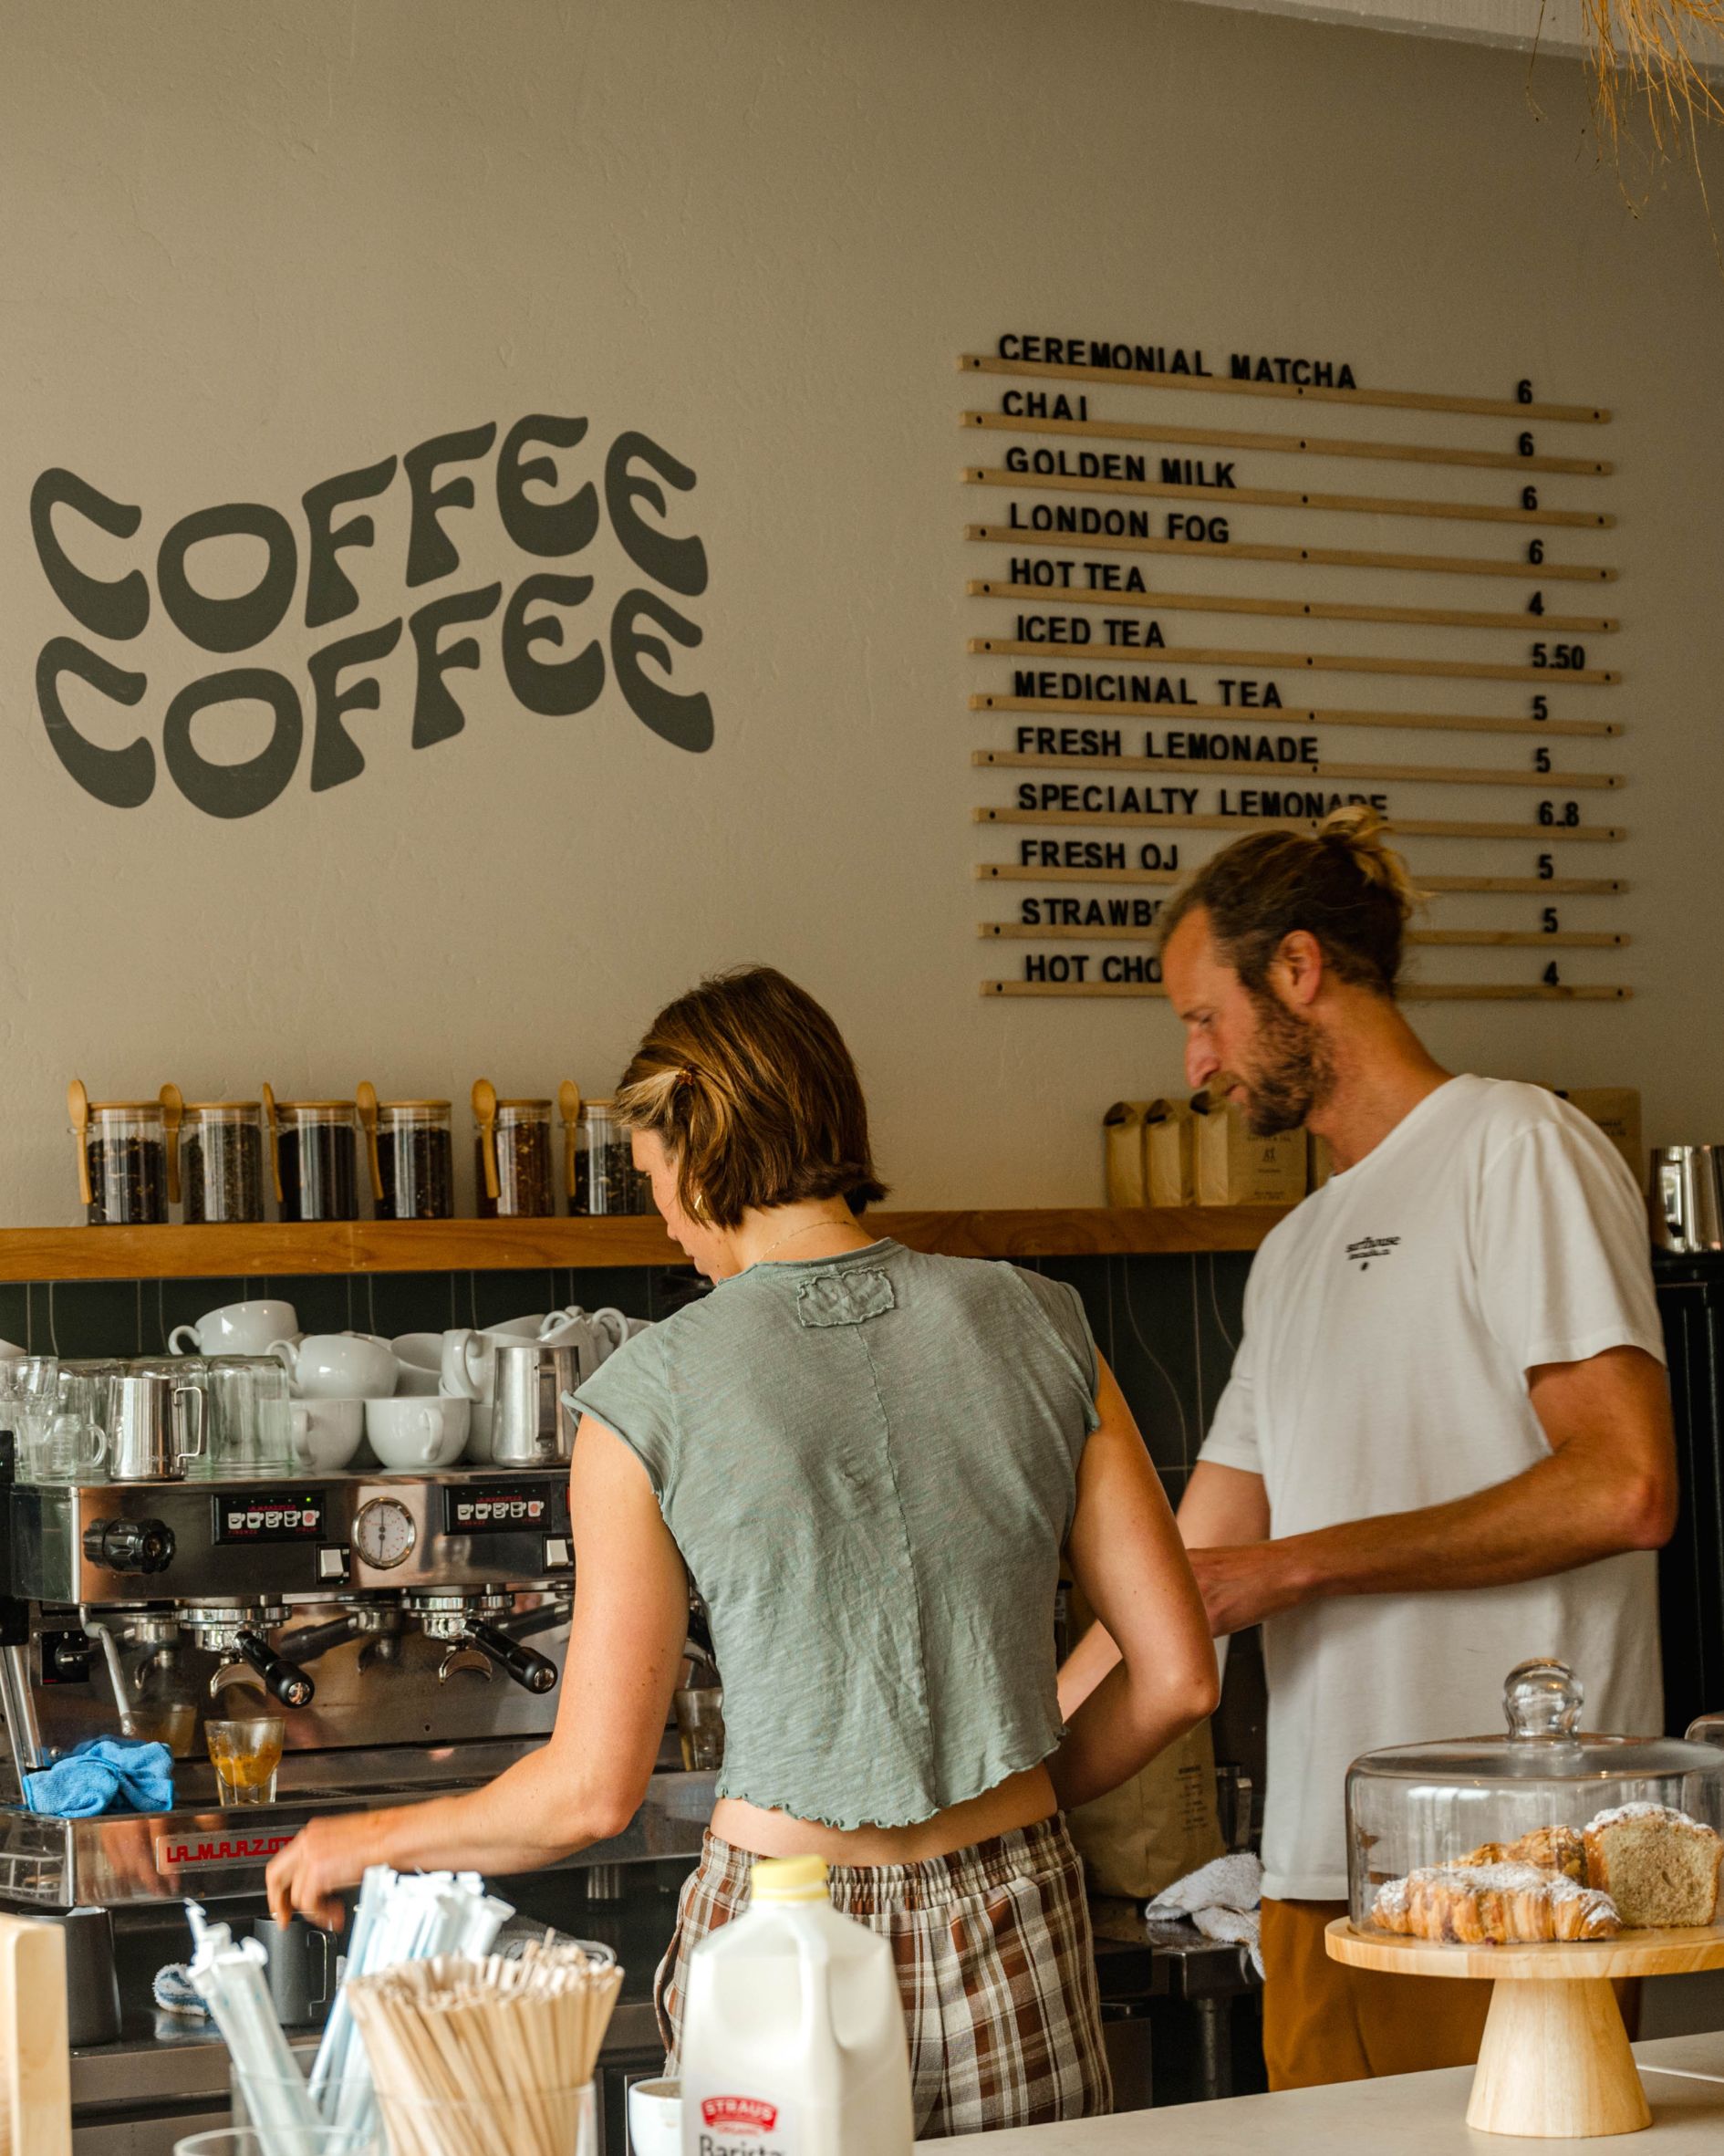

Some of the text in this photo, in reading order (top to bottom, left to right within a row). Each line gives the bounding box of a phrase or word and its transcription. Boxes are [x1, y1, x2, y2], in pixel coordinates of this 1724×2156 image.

[999, 334, 1533, 405] CEREMONIAL MATCHA 6
[1002, 391, 1534, 457] CHAI 6
[1005, 447, 1538, 511] GOLDEN MILK 6
[30, 413, 709, 653] COFFEE
[1010, 503, 1544, 565] LONDON FOG 6
[1011, 557, 1545, 617] HOT TEA 4
[1017, 615, 1586, 671] ICED TEA 5.50
[36, 573, 715, 819] COFFEE
[1014, 671, 1548, 722] MEDICINAL TEA 5
[1017, 727, 1551, 774] FRESH LEMONADE 5
[1018, 783, 1199, 815] SPECIALTY
[1538, 800, 1580, 828] 6.8
[1021, 839, 1553, 880] FRESH OJ 5
[1022, 898, 1558, 933] STRAWB 5
[1025, 954, 1089, 984] HOT
[1542, 961, 1560, 987] 4
[167, 1844, 189, 1863] LA
[704, 2099, 774, 2122] STRAUS
